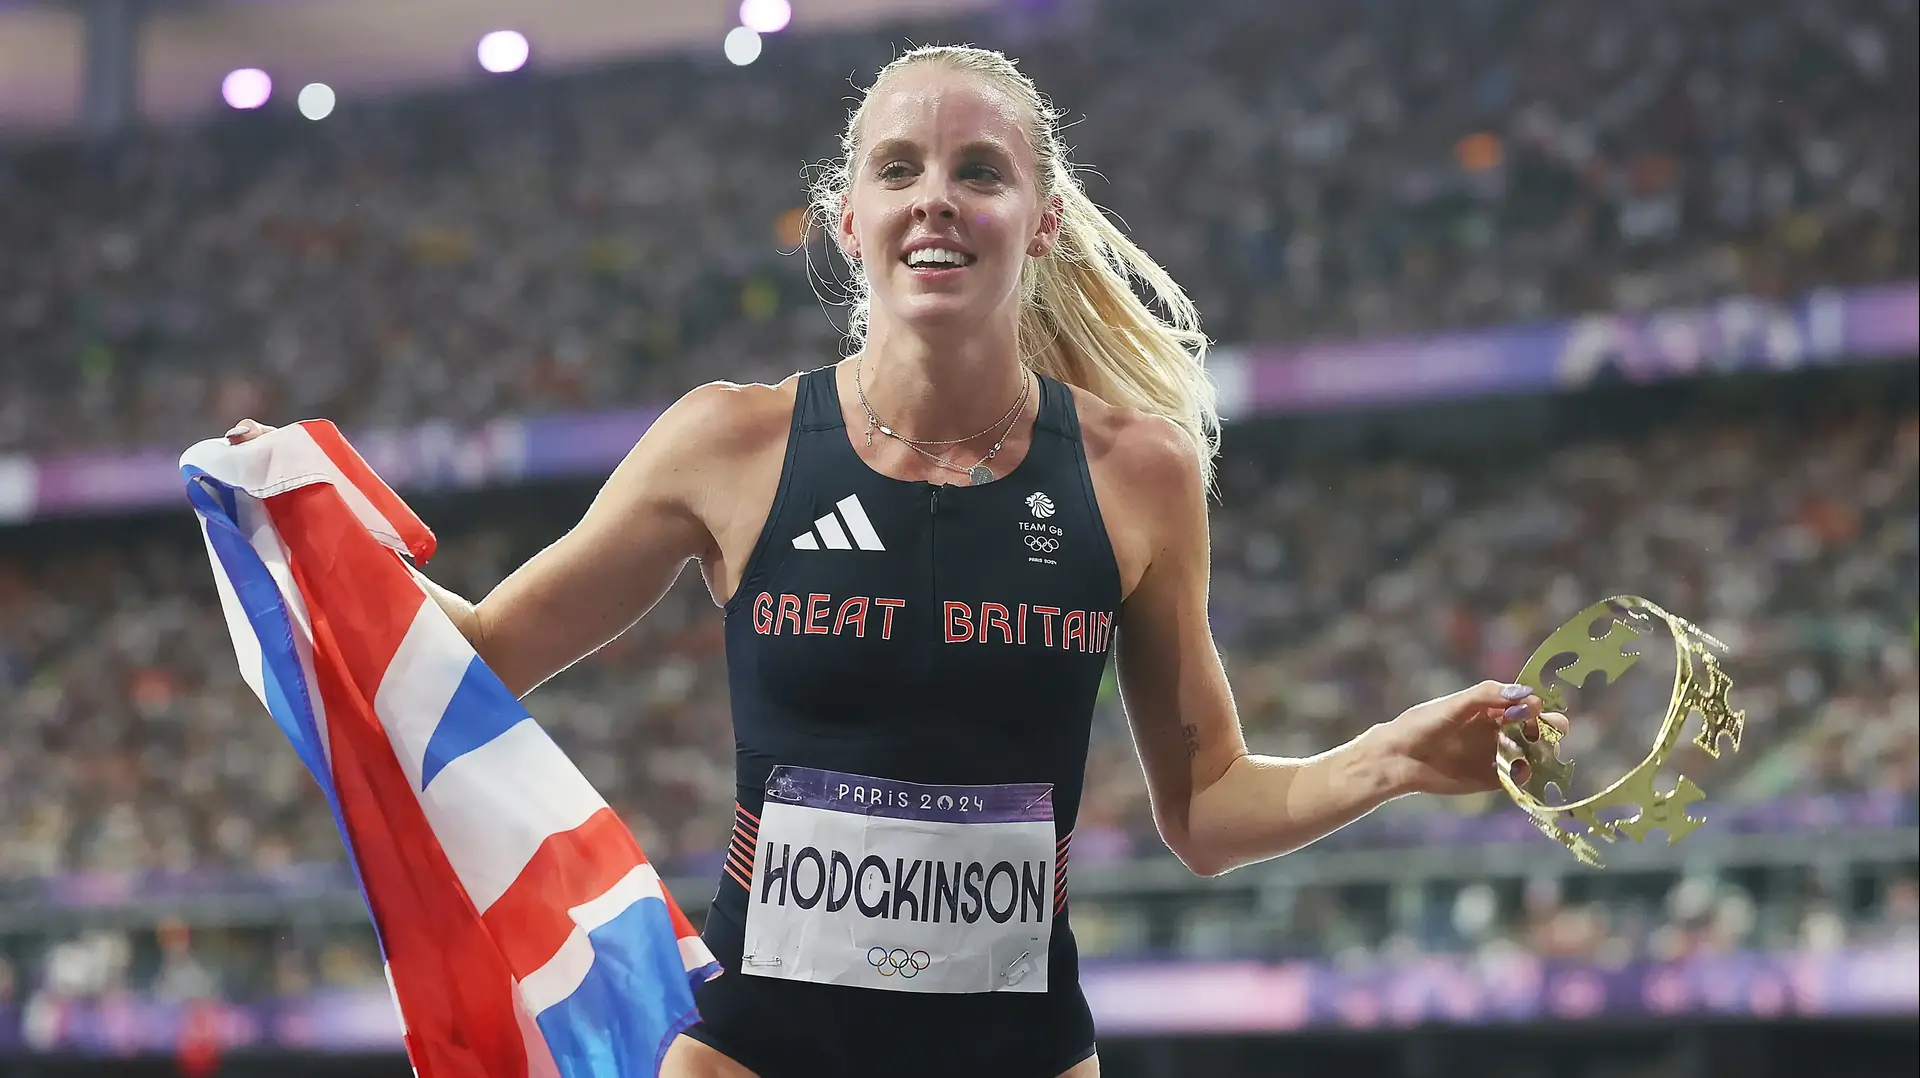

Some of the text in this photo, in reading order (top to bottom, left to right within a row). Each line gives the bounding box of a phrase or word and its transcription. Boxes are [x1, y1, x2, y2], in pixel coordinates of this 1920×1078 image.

[1018, 521, 1063, 536] TEAM GB
[753, 591, 1113, 653] GREAT BRITAIN
[920, 793, 984, 812] 2024
[760, 841, 1046, 924] HODGKINSON
